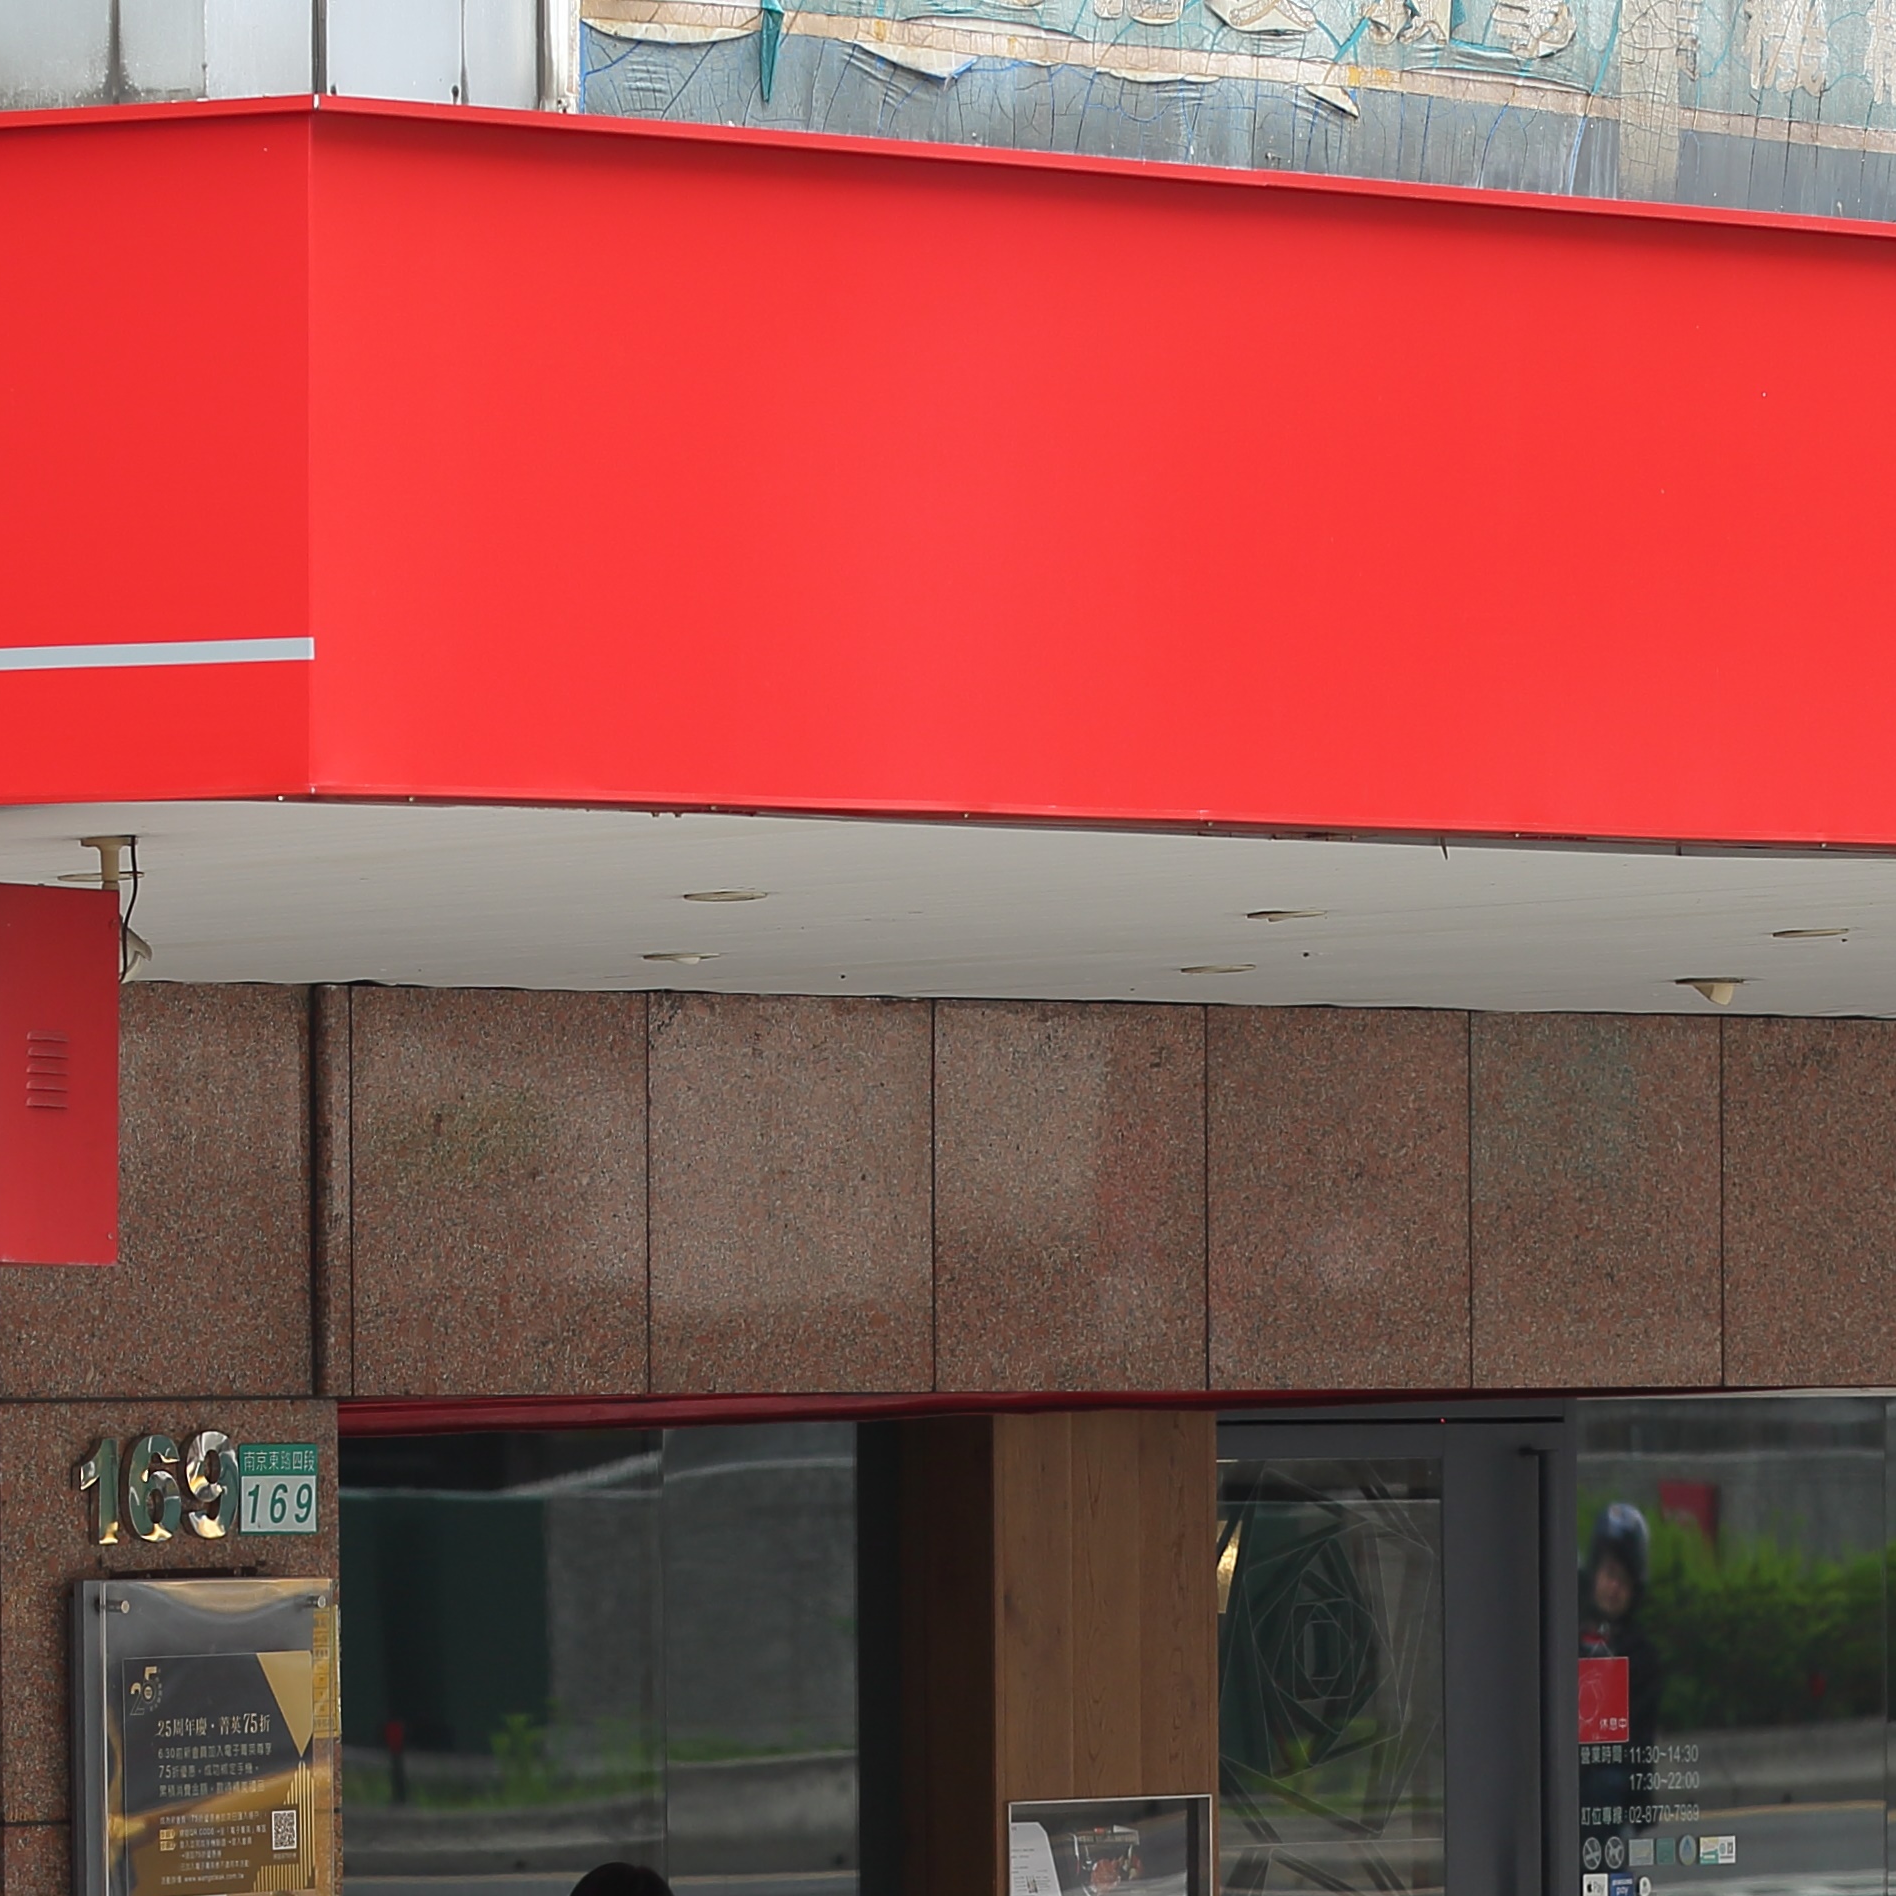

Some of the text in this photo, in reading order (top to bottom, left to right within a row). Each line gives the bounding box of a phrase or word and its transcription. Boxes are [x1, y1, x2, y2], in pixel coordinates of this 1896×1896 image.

[243, 1449, 316, 1473] 南京東路四段
[79, 1430, 239, 1544] 169
[247, 1482, 313, 1524] 169
[1599, 1717, 1629, 1731] 休息中
[1628, 1773, 1701, 1791] 17:30~22:00
